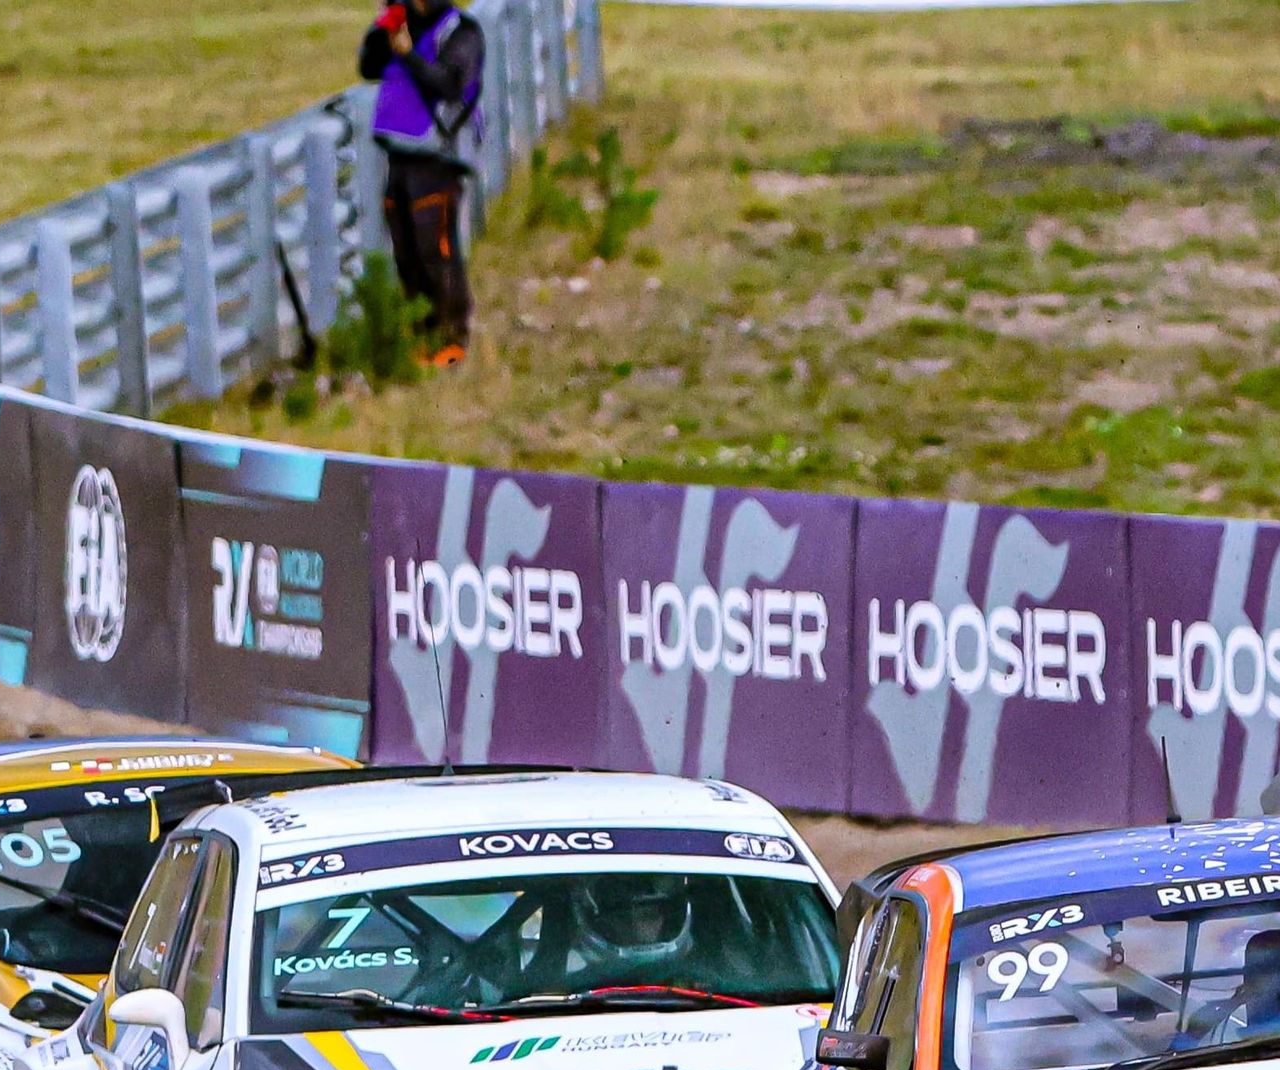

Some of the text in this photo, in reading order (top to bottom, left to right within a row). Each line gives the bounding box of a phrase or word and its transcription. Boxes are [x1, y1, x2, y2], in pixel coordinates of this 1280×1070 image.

[385, 556, 583, 659] HOOSIER
[619, 579, 828, 682] HOOSIER
[868, 597, 1108, 703] HOOSIER
[459, 832, 614, 856] KOVACS
[326, 907, 371, 949] 7
[274, 947, 420, 976] Kovács S.
[987, 941, 1070, 1002] 99
